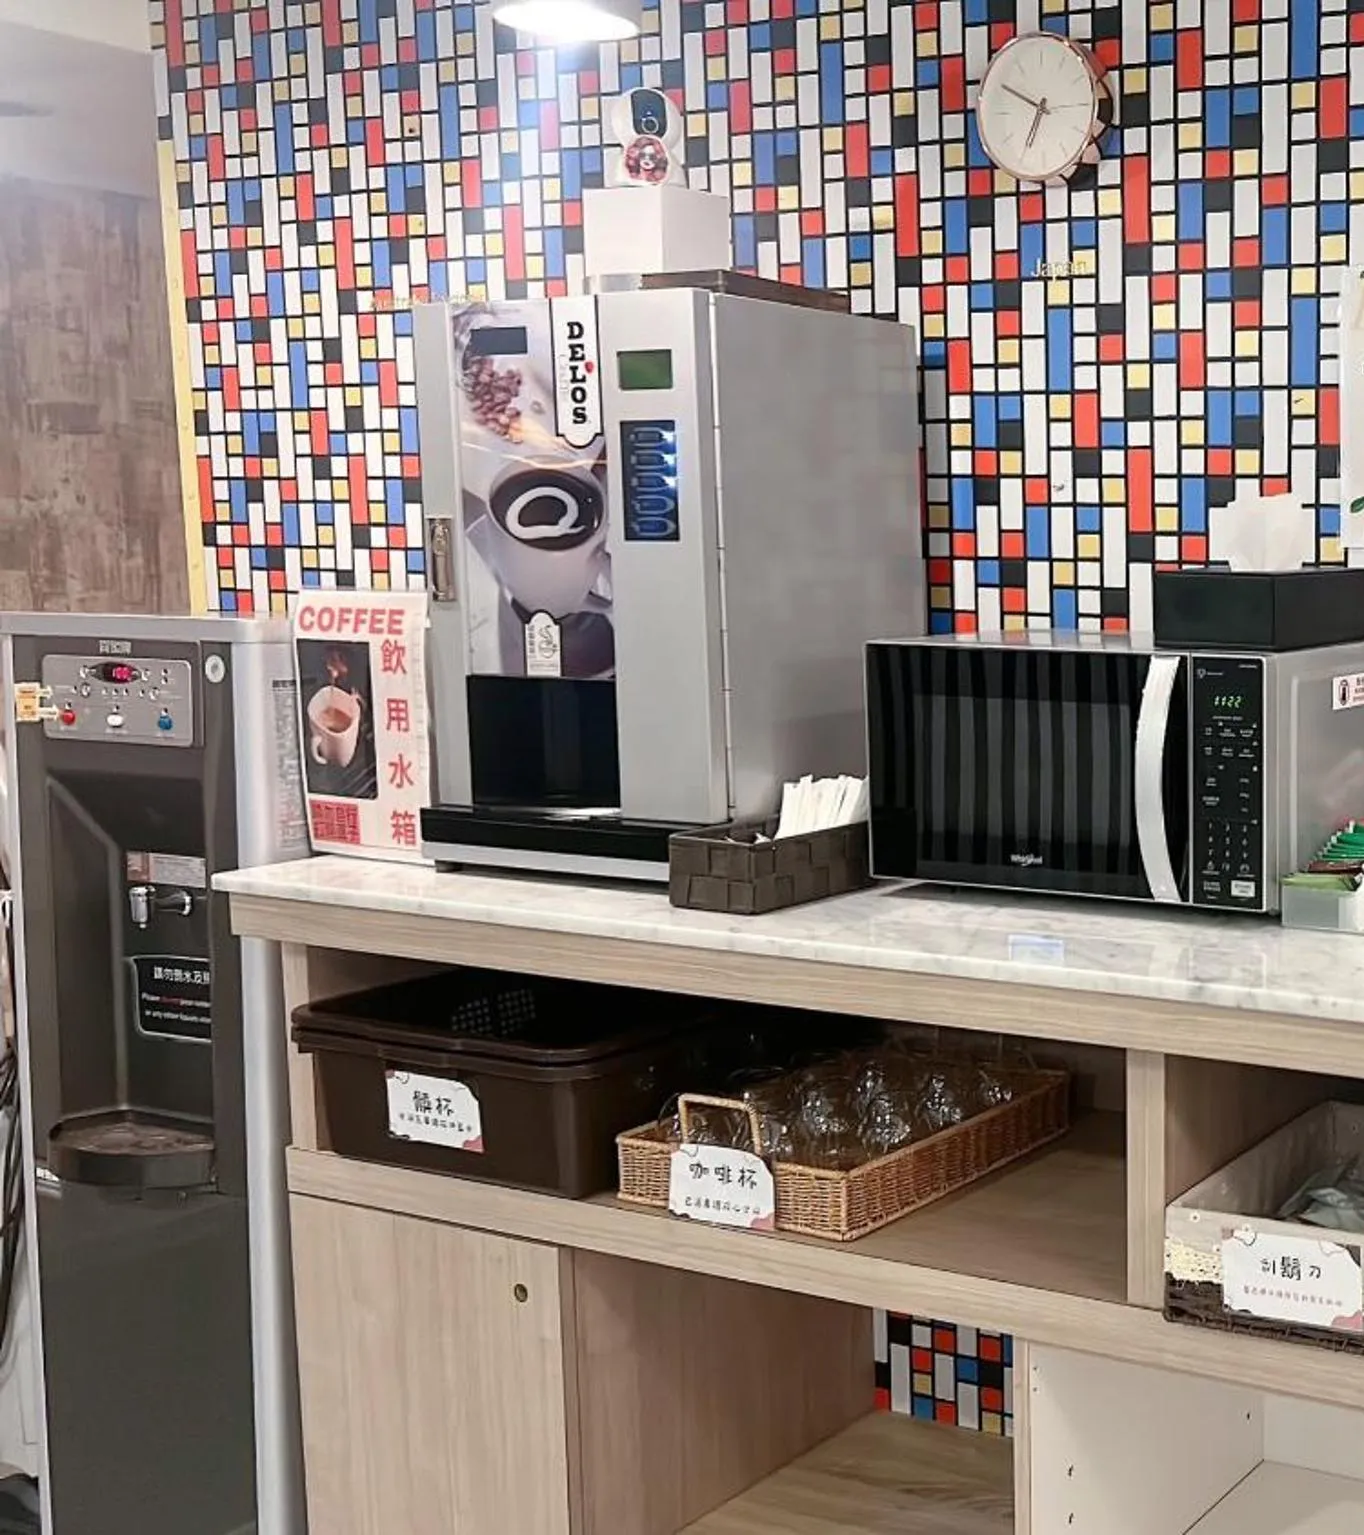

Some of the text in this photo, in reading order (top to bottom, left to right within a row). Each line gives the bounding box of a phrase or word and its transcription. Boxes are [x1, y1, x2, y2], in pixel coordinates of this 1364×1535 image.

[567, 321, 587, 424] DELOS
[299, 606, 406, 636] COFFEE
[380, 638, 418, 846] 飲用水箱
[689, 1162, 758, 1191] 咖啡杯
